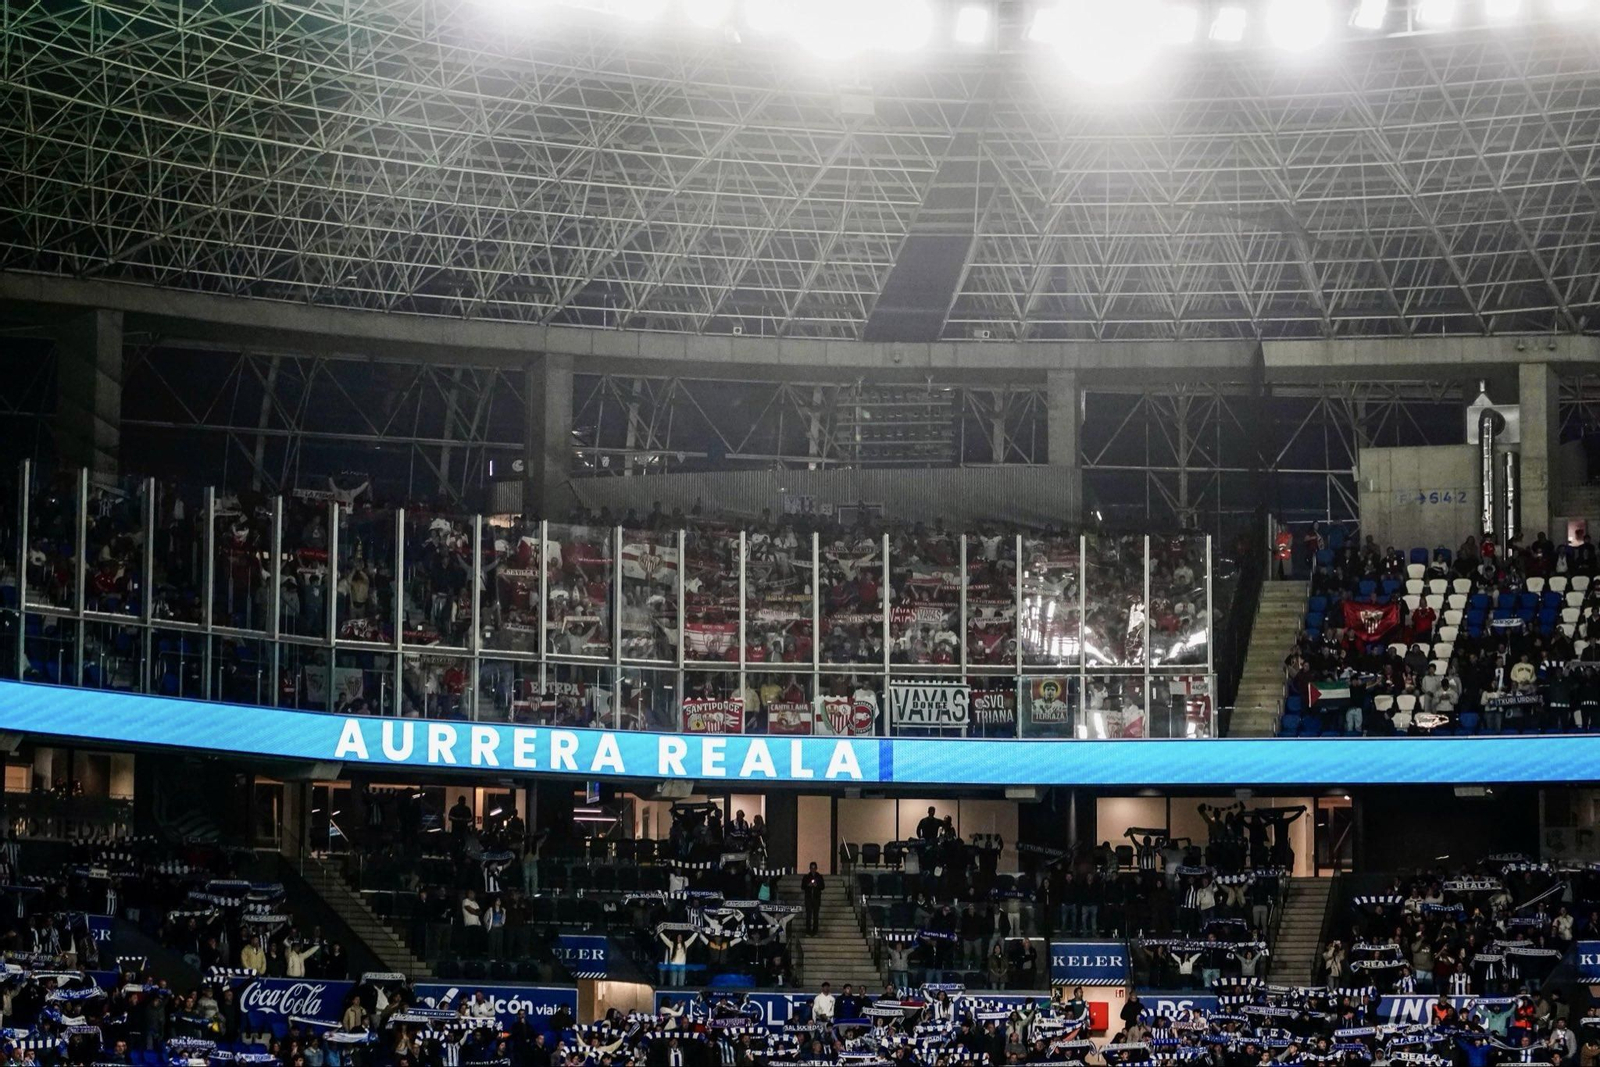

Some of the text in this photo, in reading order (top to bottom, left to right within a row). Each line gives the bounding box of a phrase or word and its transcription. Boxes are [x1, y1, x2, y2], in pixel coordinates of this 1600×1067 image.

[889, 607, 916, 622] VAYAS
[530, 681, 580, 696] ETEPA
[893, 688, 966, 722] VAYAS
[983, 694, 1004, 708] SVQ
[975, 709, 1014, 723] TRIANA
[334, 718, 863, 781] AURRERA REALA
[1456, 881, 1492, 890] REALA
[551, 948, 605, 960] ELER
[1052, 955, 1123, 967] KELER
[1361, 959, 1399, 969] REALA
